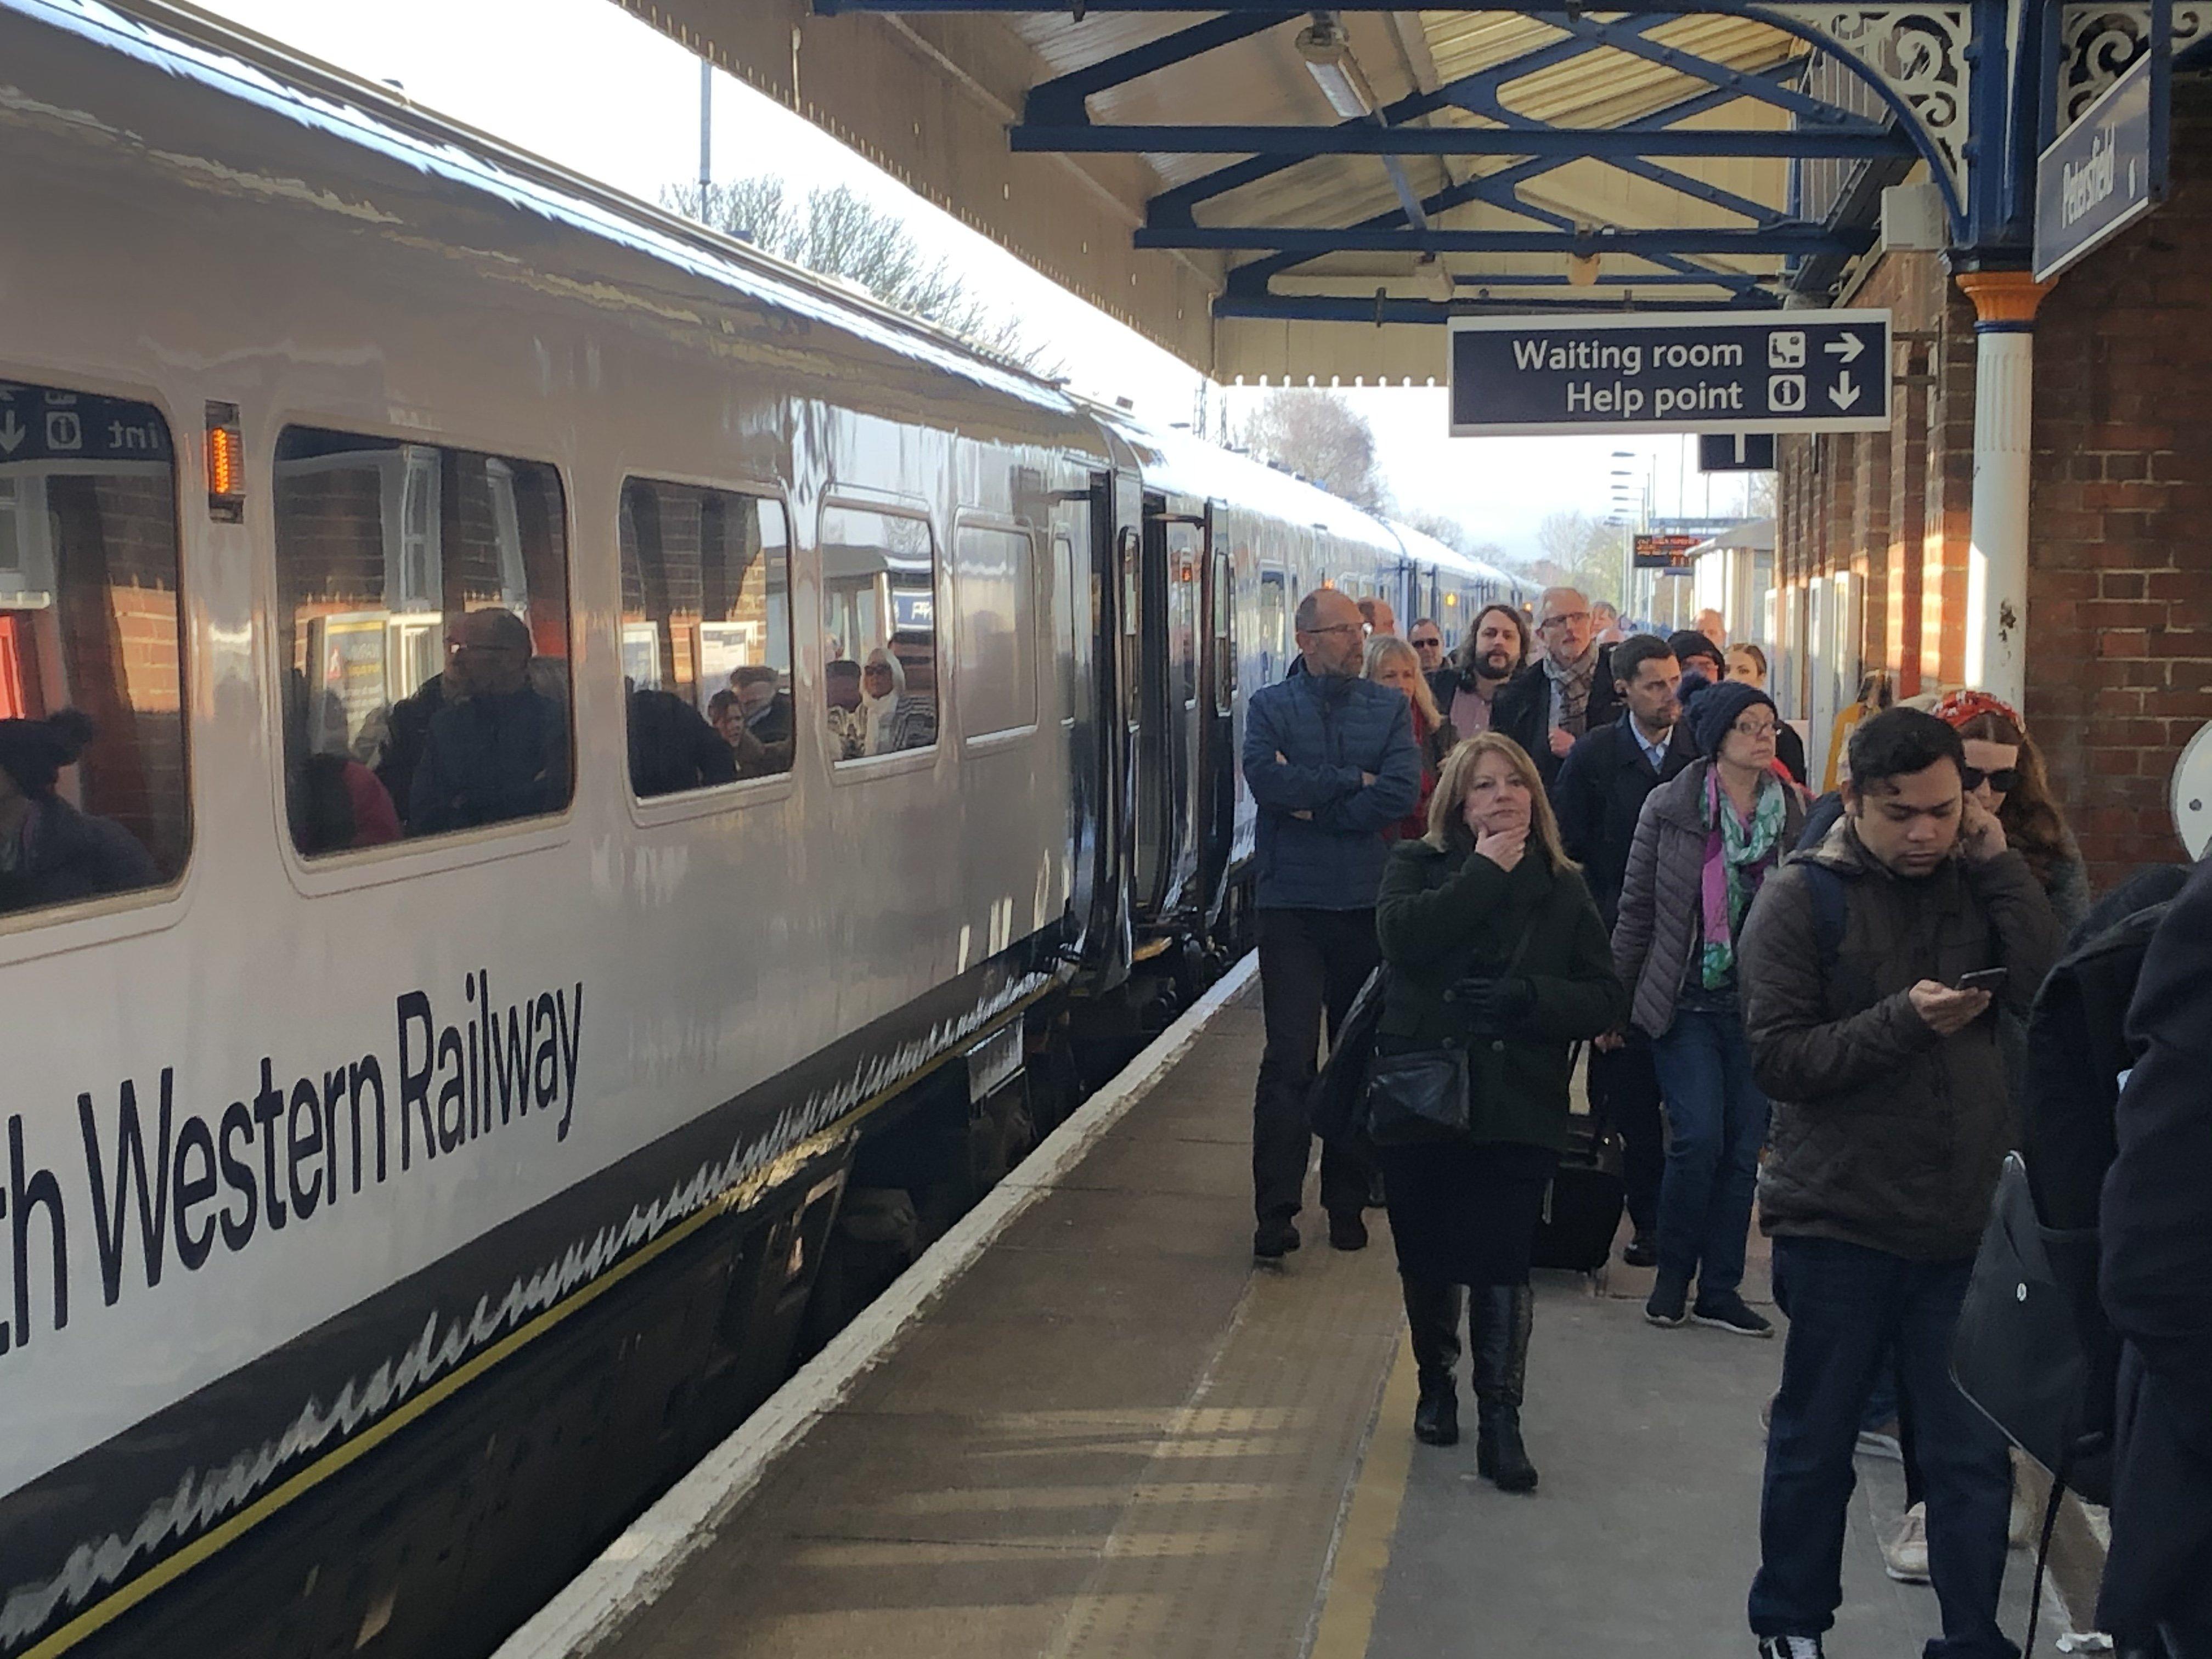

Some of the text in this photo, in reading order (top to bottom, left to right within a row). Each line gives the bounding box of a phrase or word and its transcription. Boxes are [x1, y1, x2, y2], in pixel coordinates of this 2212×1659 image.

[1512, 338, 1743, 376] Waiting room
[1566, 380, 1744, 418] Help point
[77, 1054, 386, 1307] Western
[397, 968, 583, 1172] Railway
